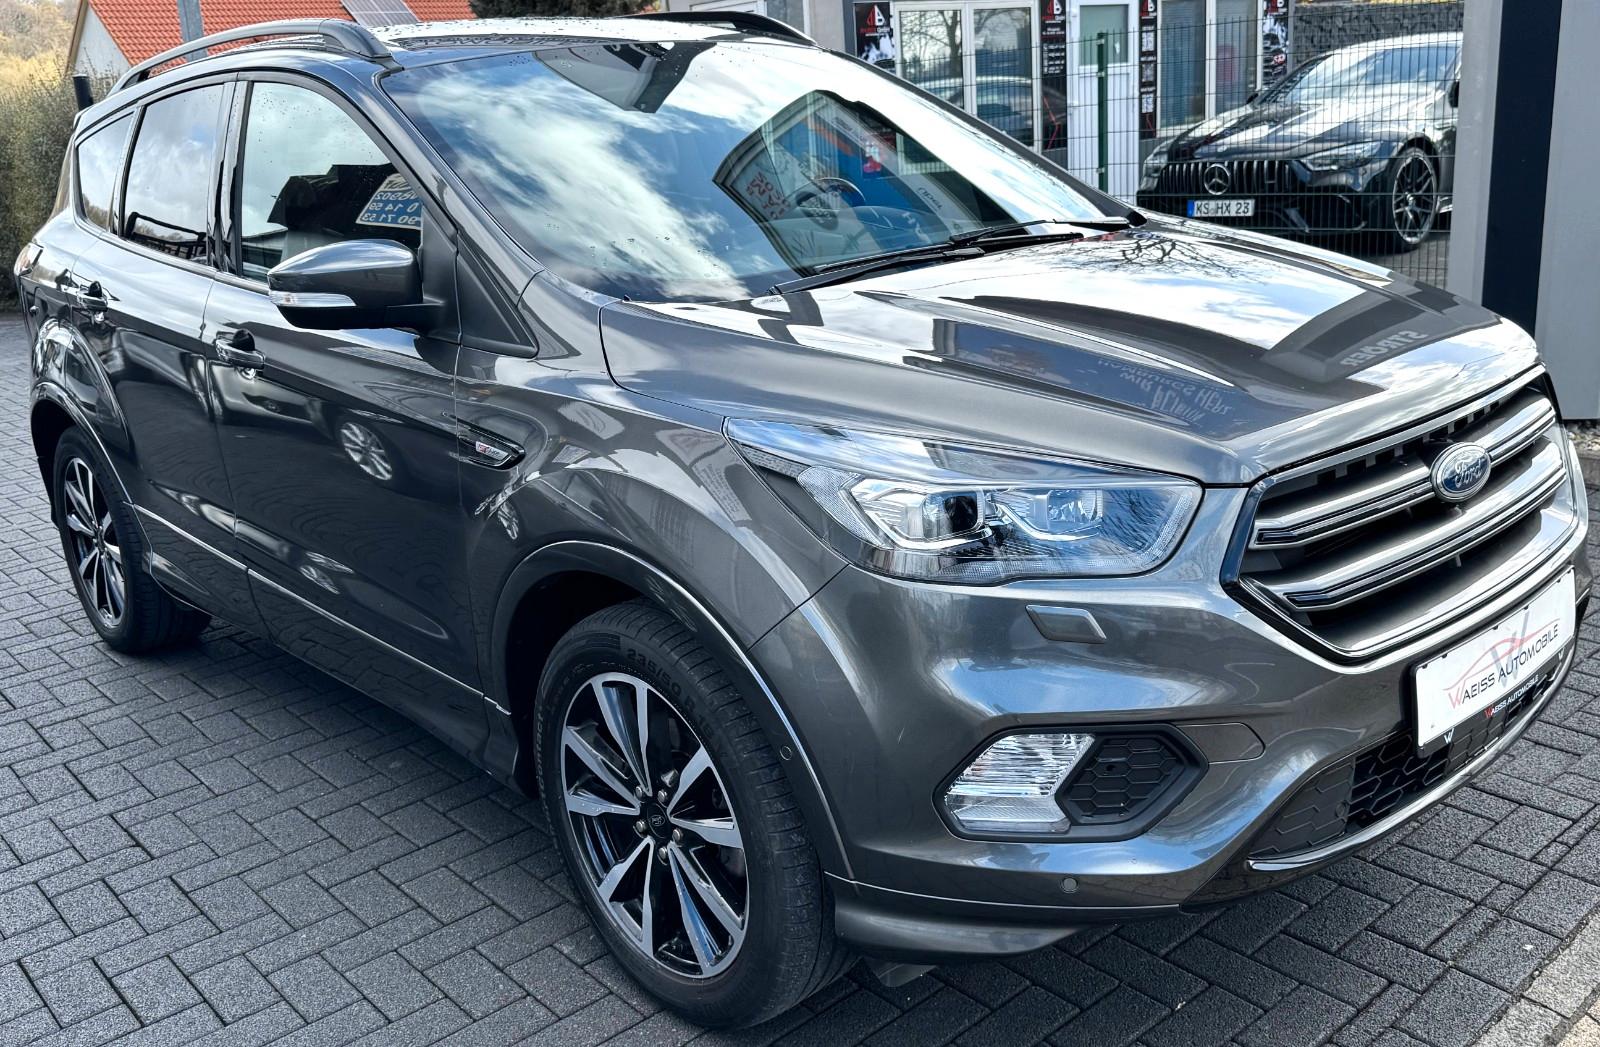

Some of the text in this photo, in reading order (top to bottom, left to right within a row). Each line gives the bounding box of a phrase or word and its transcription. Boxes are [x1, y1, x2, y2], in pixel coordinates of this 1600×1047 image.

[1196, 202, 1250, 214] KS HX 23
[1498, 624, 1558, 682] AUTOMOBILE
[1507, 674, 1539, 705] AUTOMOBILE
